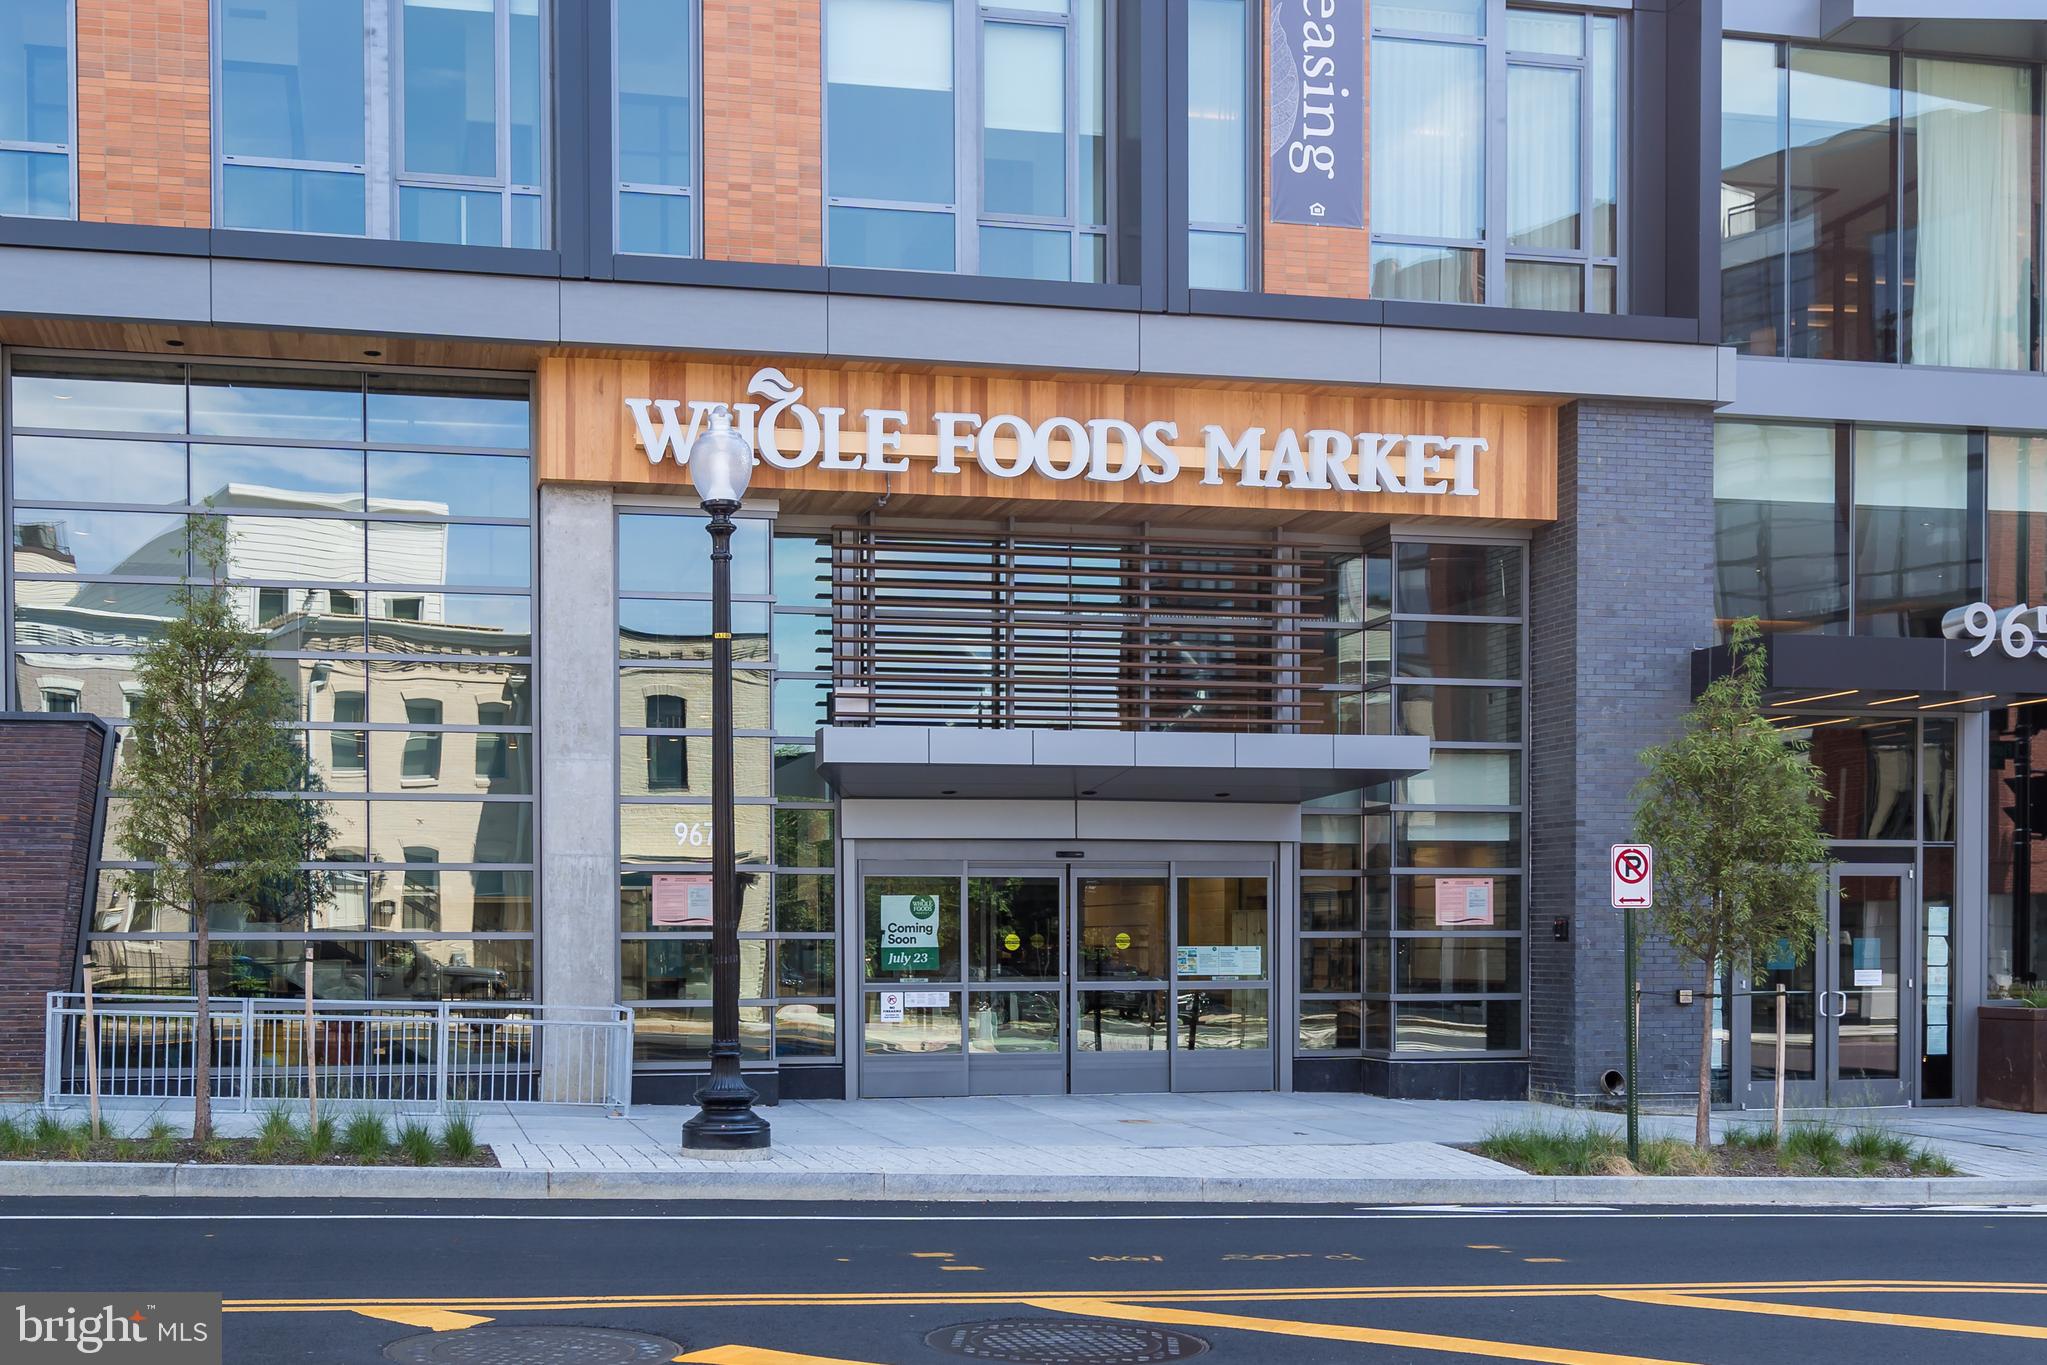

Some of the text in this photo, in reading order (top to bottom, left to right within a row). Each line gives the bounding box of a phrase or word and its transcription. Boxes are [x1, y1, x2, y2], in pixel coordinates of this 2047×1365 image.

[932, 411, 1181, 484] FOODS
[1199, 425, 1489, 496] MARKET
[887, 922, 933, 935] Coming
[887, 934, 917, 945] Soon
[888, 951, 928, 966] July 23
